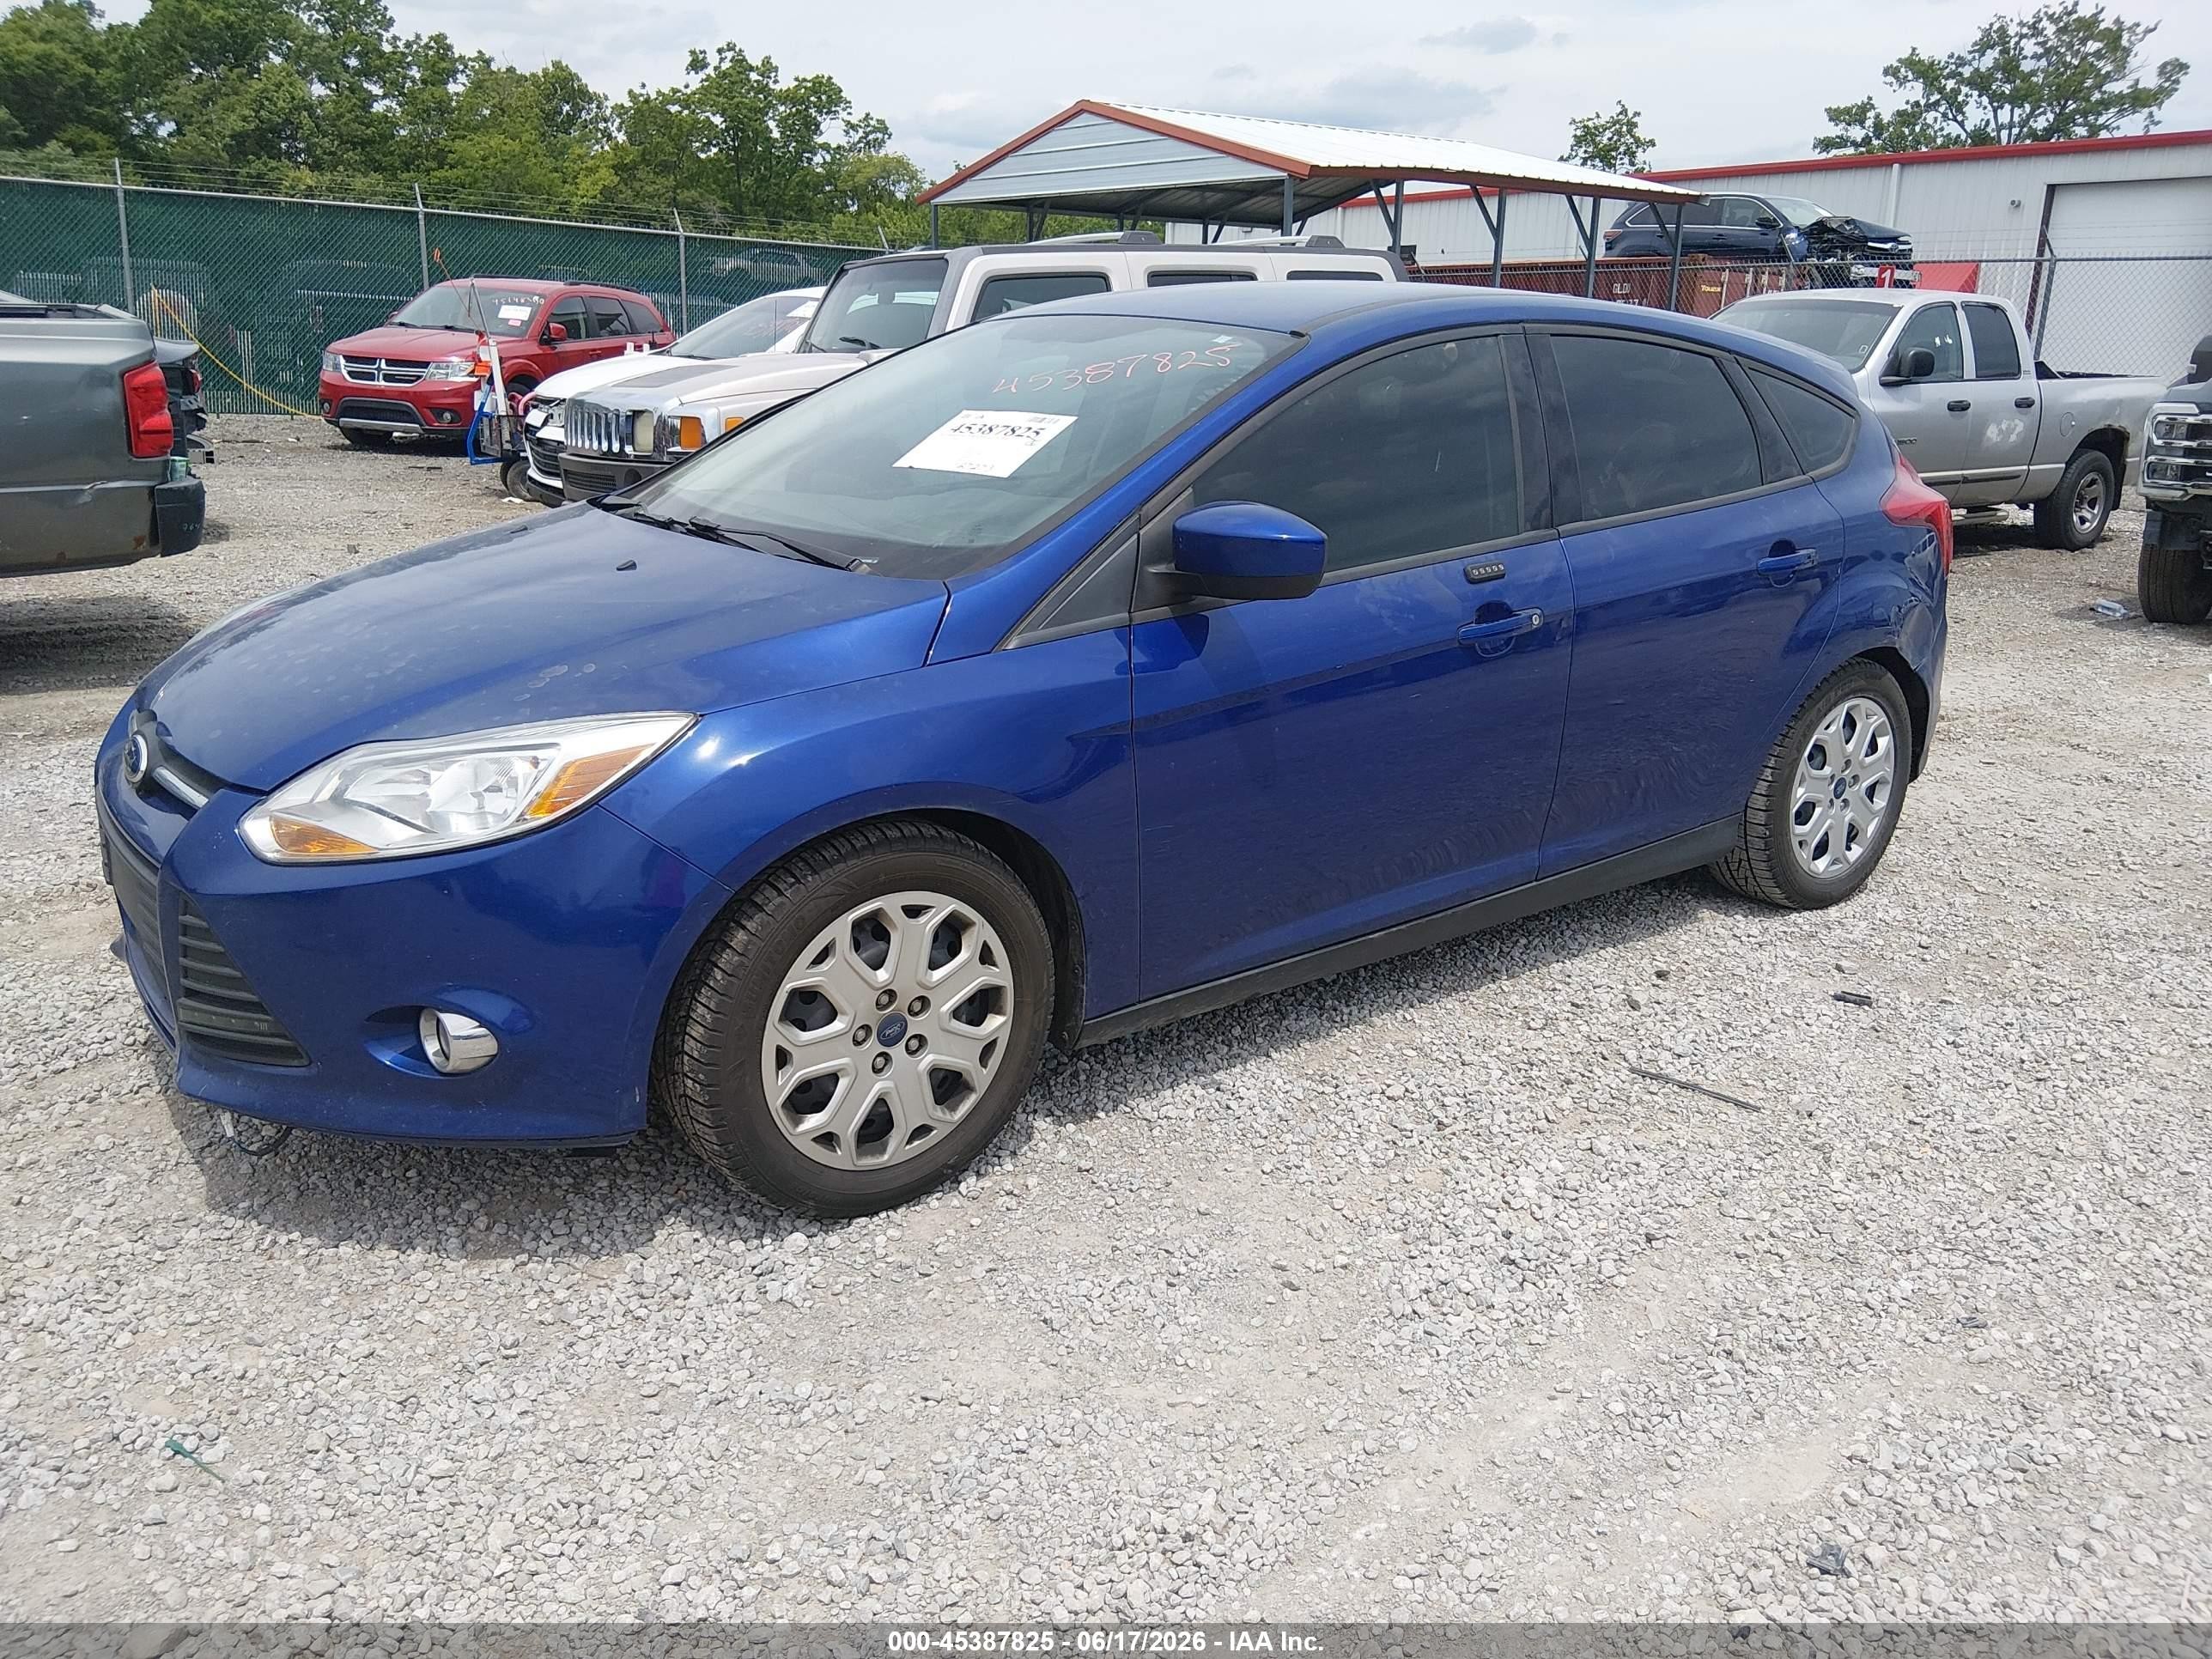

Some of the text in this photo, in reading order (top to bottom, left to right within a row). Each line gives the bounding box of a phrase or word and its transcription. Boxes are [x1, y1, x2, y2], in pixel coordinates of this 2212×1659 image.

[1881, 268, 1892, 289] 1
[992, 343, 1243, 393] 45387825
[951, 422, 1045, 438] 45387825
